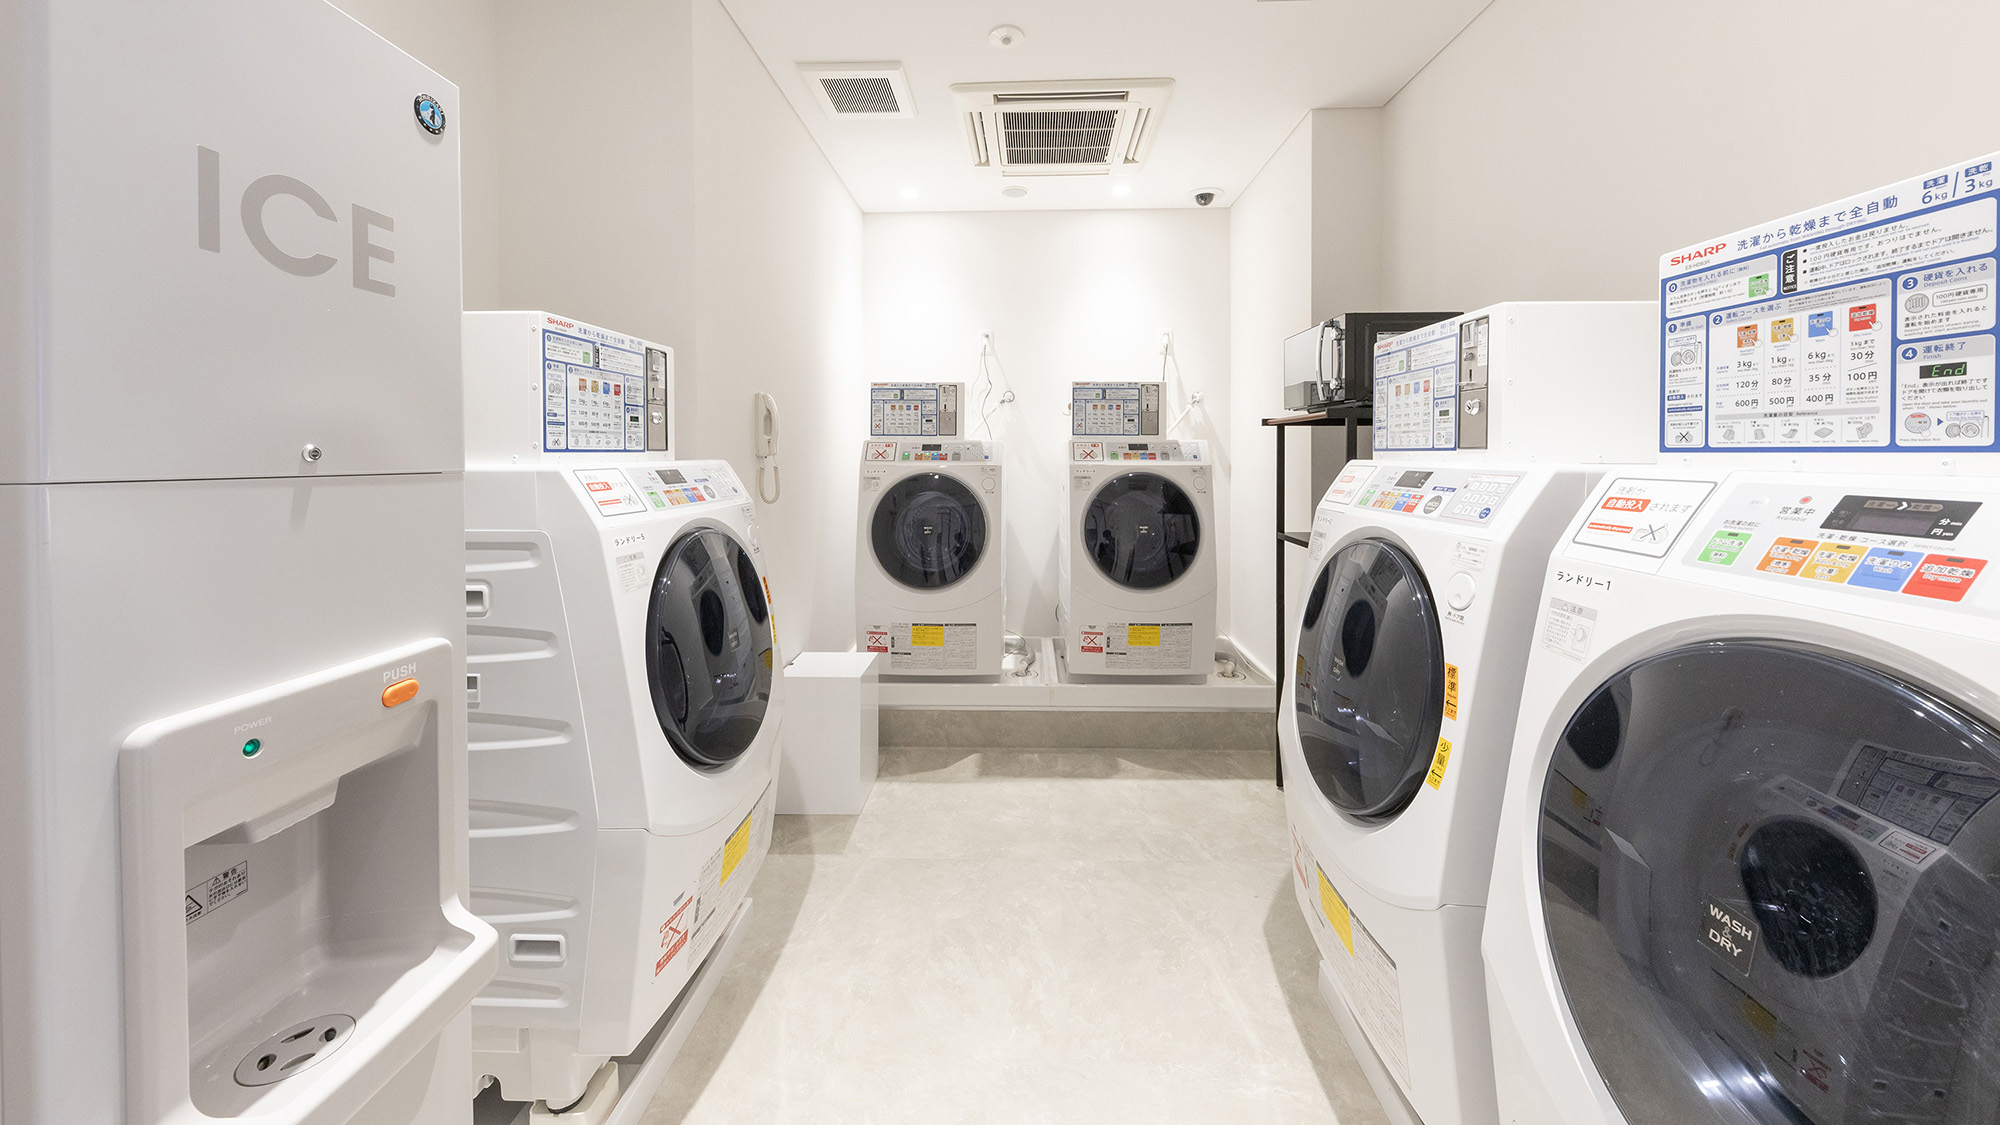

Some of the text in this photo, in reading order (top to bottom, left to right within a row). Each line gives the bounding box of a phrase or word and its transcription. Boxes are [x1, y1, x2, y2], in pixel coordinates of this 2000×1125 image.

[197, 143, 396, 299] ICE
[1737, 195, 1898, 252] 洗濯から乾燥まで全自動
[1670, 242, 1727, 266] SHARP
[1785, 254, 1796, 284] ご注意
[1923, 263, 1988, 282] 硬貨を入れる
[1907, 279, 1914, 288] 3
[1924, 279, 1947, 288] Deposit
[1936, 287, 1984, 300] 100円硬貨専用
[1726, 303, 1782, 319] 運転コースを選ぶ
[547, 317, 574, 329] SHARP
[1905, 349, 1913, 358] 4
[1922, 342, 1966, 354] 運転終了
[1850, 351, 1874, 360] 30分
[1848, 371, 1877, 381] 100円
[1932, 363, 1966, 377] End
[1772, 377, 1792, 385] 80分
[1809, 373, 1831, 382] 35分
[1736, 380, 1758, 388] 120分
[1735, 399, 1758, 407] 600円
[1769, 396, 1794, 405] 500円
[1806, 394, 1834, 402] 400円
[1606, 498, 1693, 513] 自動投入 されます
[1780, 507, 1816, 516] 営業中
[1938, 518, 1951, 526] 分
[1931, 528, 1943, 536] 円
[1860, 537, 1909, 547] コース選択
[1866, 557, 1913, 569] 洗濯のみ
[1922, 564, 1975, 578] 追加乾燥
[1557, 571, 1612, 590] ランドリー1
[1922, 573, 1962, 583] Dry more
[1570, 605, 1583, 615] 注意
[383, 662, 417, 683] PUSH
[1447, 666, 1456, 692] 標準
[234, 716, 272, 734] POWER
[1437, 742, 1449, 767] 少量
[1710, 904, 1752, 941] WASH
[1722, 926, 1732, 941] &
[1709, 928, 1742, 957] DRY
